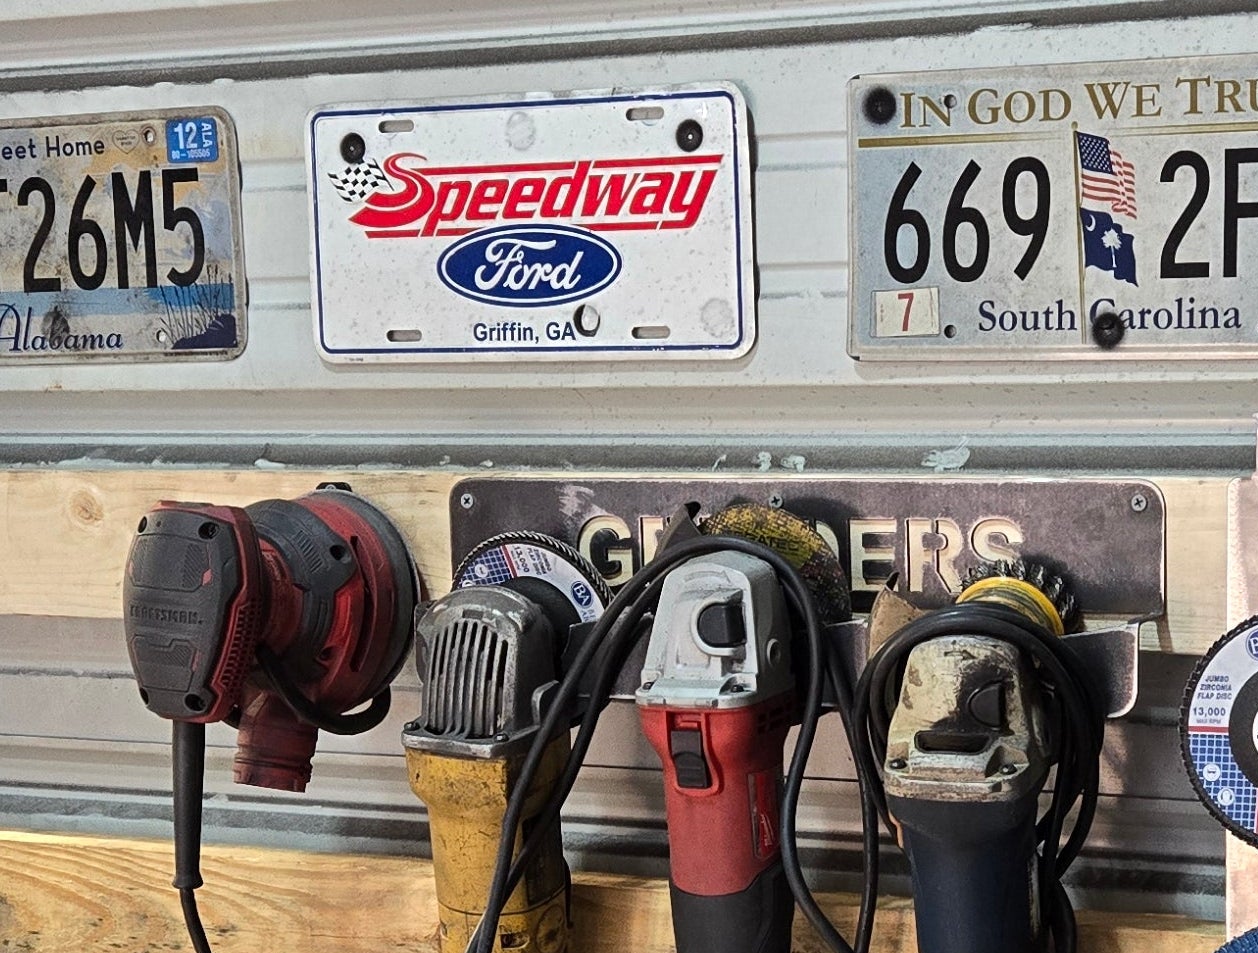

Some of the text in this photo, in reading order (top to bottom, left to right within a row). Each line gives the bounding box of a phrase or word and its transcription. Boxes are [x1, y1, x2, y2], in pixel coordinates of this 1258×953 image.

[900, 91, 952, 128] IN
[967, 86, 1072, 124] GOD
[1084, 81, 1163, 120] WE
[45, 135, 105, 158] Home
[174, 122, 198, 149] 12
[201, 122, 213, 148] ALA
[348, 151, 723, 239] Speedway
[883, 155, 1052, 285] 669
[473, 239, 585, 290] Ford
[896, 292, 915, 333] 7
[977, 299, 1077, 332] South
[473, 321, 577, 343] Griffin, GA
[1197, 692, 1215, 700] FLAP
[1193, 706, 1226, 717] 13,000
